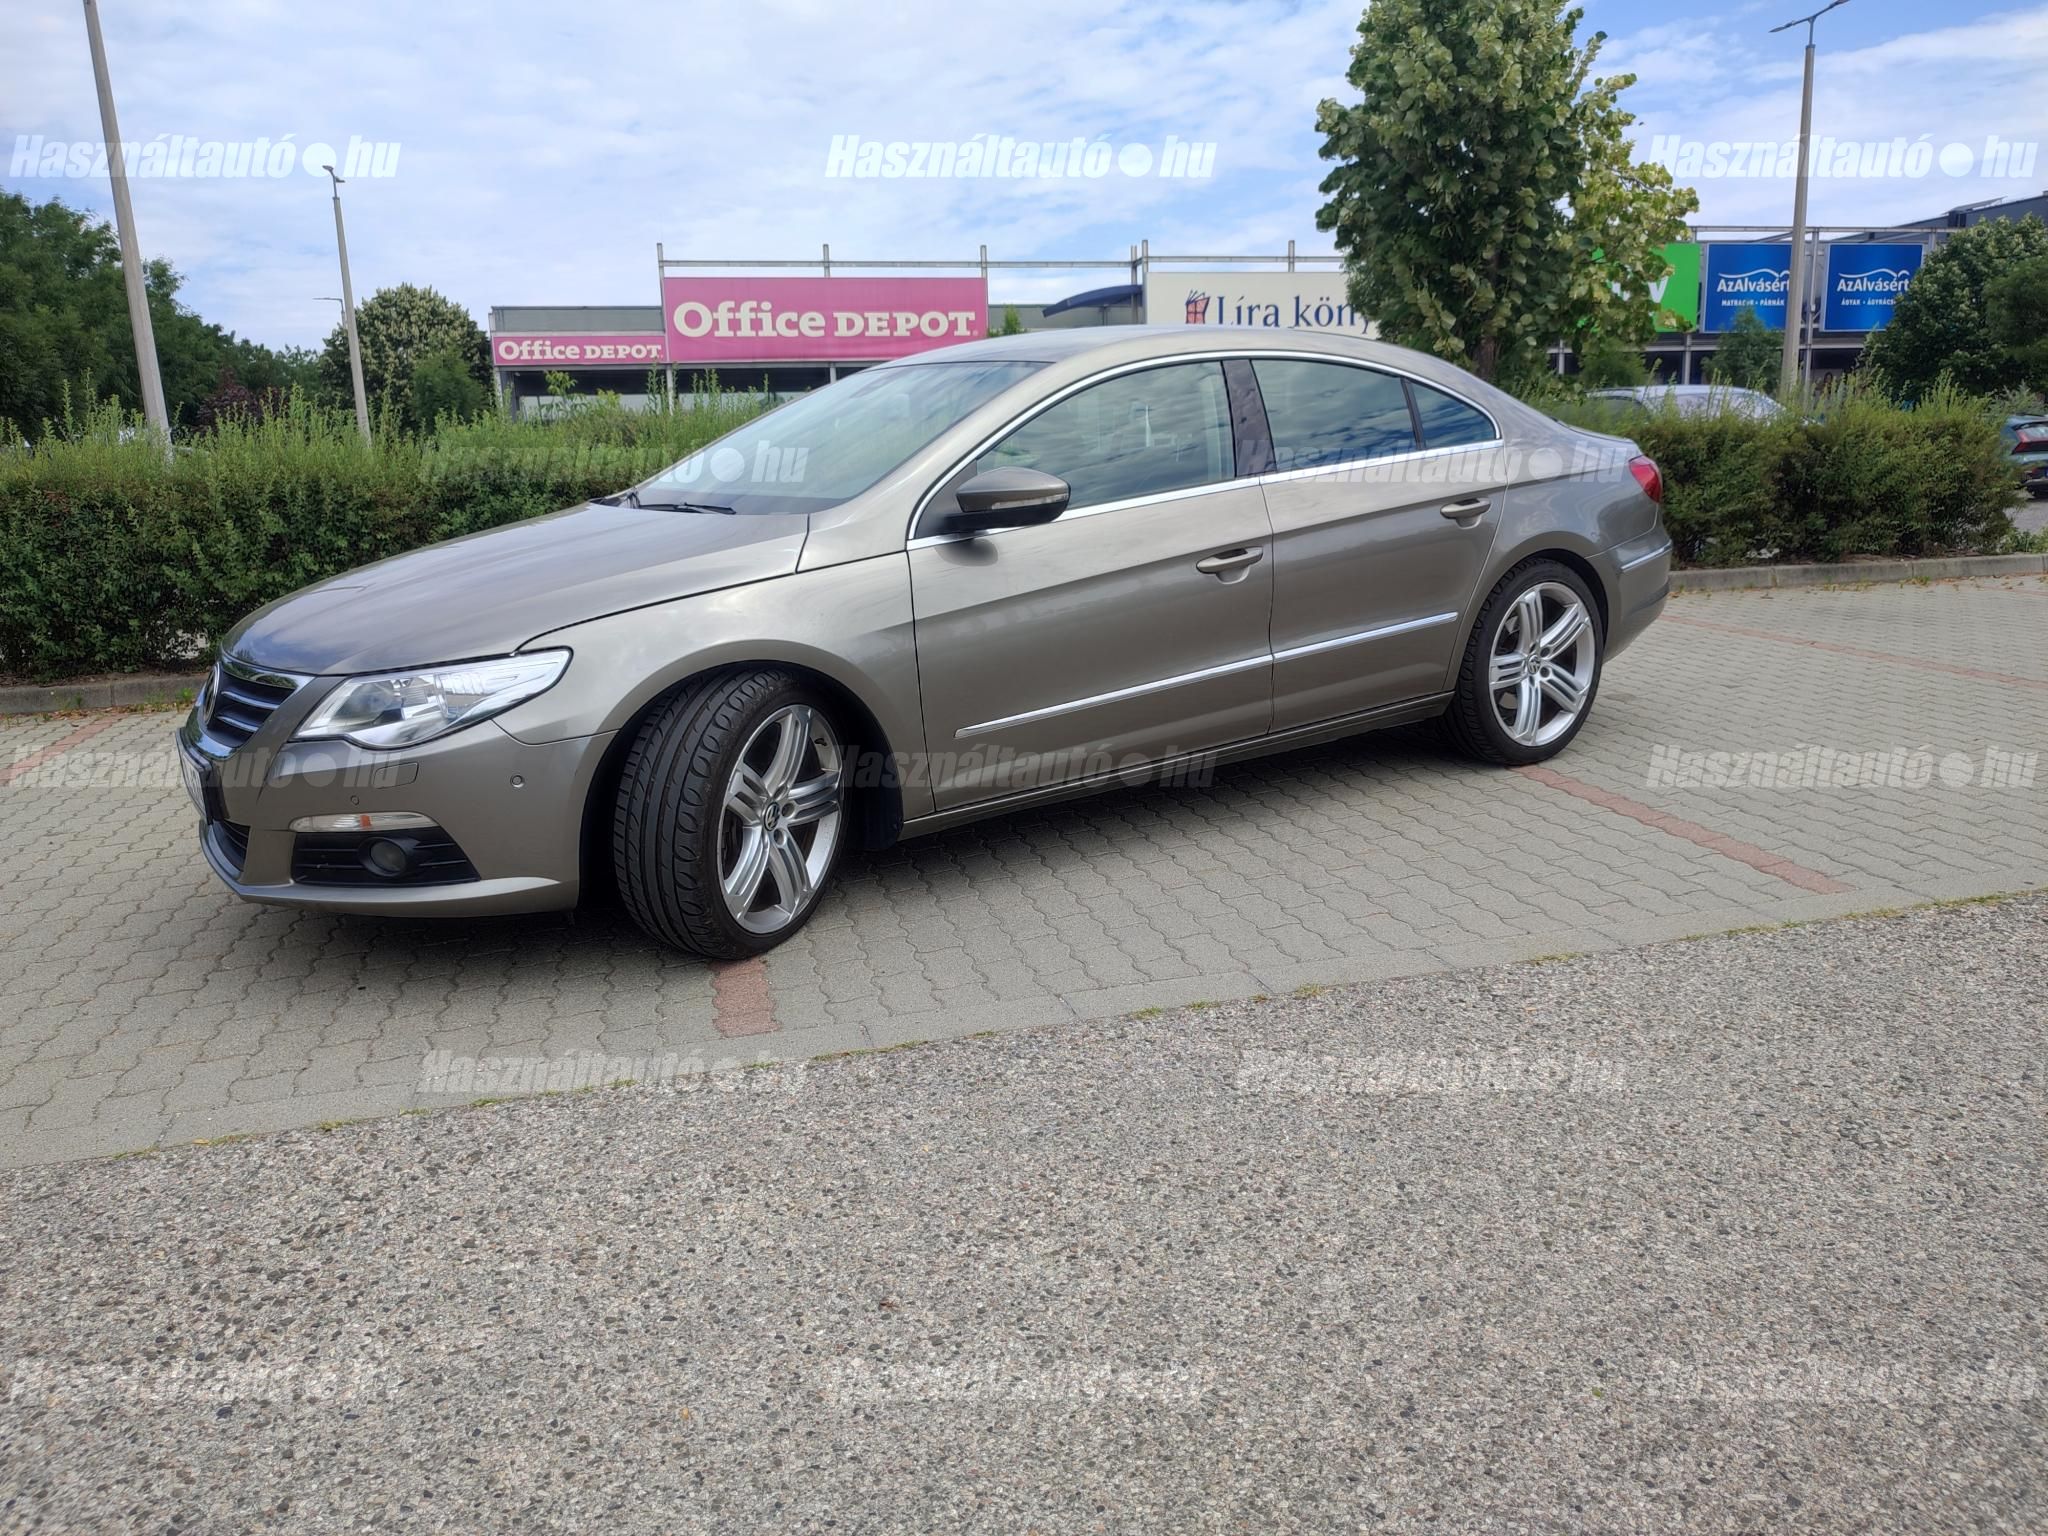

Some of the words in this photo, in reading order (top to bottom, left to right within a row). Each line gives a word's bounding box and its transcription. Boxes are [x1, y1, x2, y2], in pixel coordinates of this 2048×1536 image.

[1717, 277, 1790, 292] AzAlvásért
[1836, 277, 1909, 292] AzAlvásért
[673, 301, 826, 337] Office
[833, 311, 976, 337] DEPOT
[499, 340, 580, 360] Office
[584, 344, 662, 359] DEPOT
